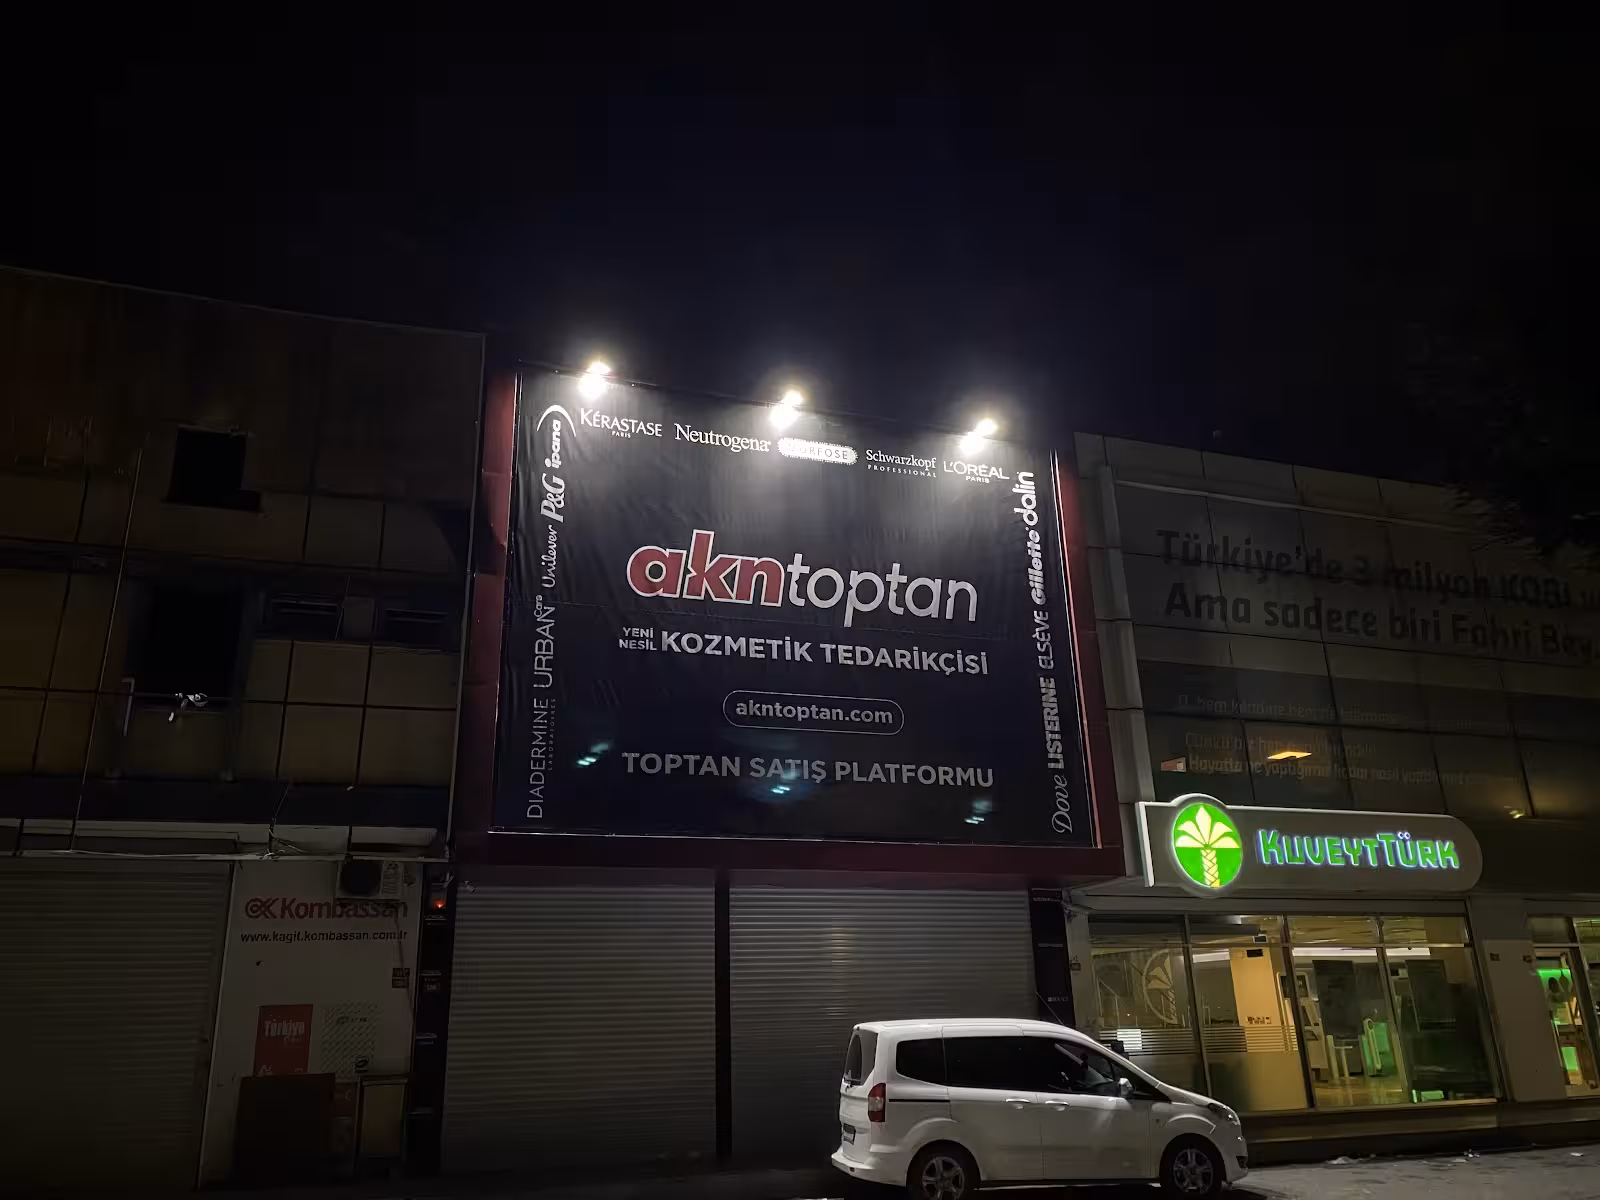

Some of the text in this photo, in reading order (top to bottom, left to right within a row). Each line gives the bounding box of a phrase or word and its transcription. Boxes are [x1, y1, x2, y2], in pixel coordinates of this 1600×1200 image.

[545, 419, 561, 469] ipana
[580, 407, 662, 437] KÉRASTASE
[612, 430, 632, 439] PARIS
[674, 423, 769, 453] Neutrogena
[865, 450, 936, 470] Schwarzkopf
[867, 464, 937, 478] PROFESSIONAL
[943, 460, 1010, 480] L'ORÉAL
[965, 475, 990, 484] PARIS
[540, 473, 565, 523] P&G
[1012, 471, 1039, 526] dalin
[541, 525, 557, 588] Unilever
[626, 529, 978, 627] akntoptan
[1027, 529, 1047, 606] Gillette
[1166, 582, 1252, 624] Ama
[1263, 597, 1378, 638] sadece
[533, 605, 556, 688] URBAN
[618, 636, 657, 651] NESİL
[622, 626, 655, 640] YENİ
[661, 630, 989, 675] KOZMETİK TEDARİKÇİSİ
[735, 700, 894, 724] akntoptan.com
[1040, 676, 1065, 770] LISTERINE
[527, 698, 549, 819] DIADERMINE
[622, 751, 994, 788] TOPTAN SATIŞ PLATFORMU
[1051, 774, 1073, 834] Dove
